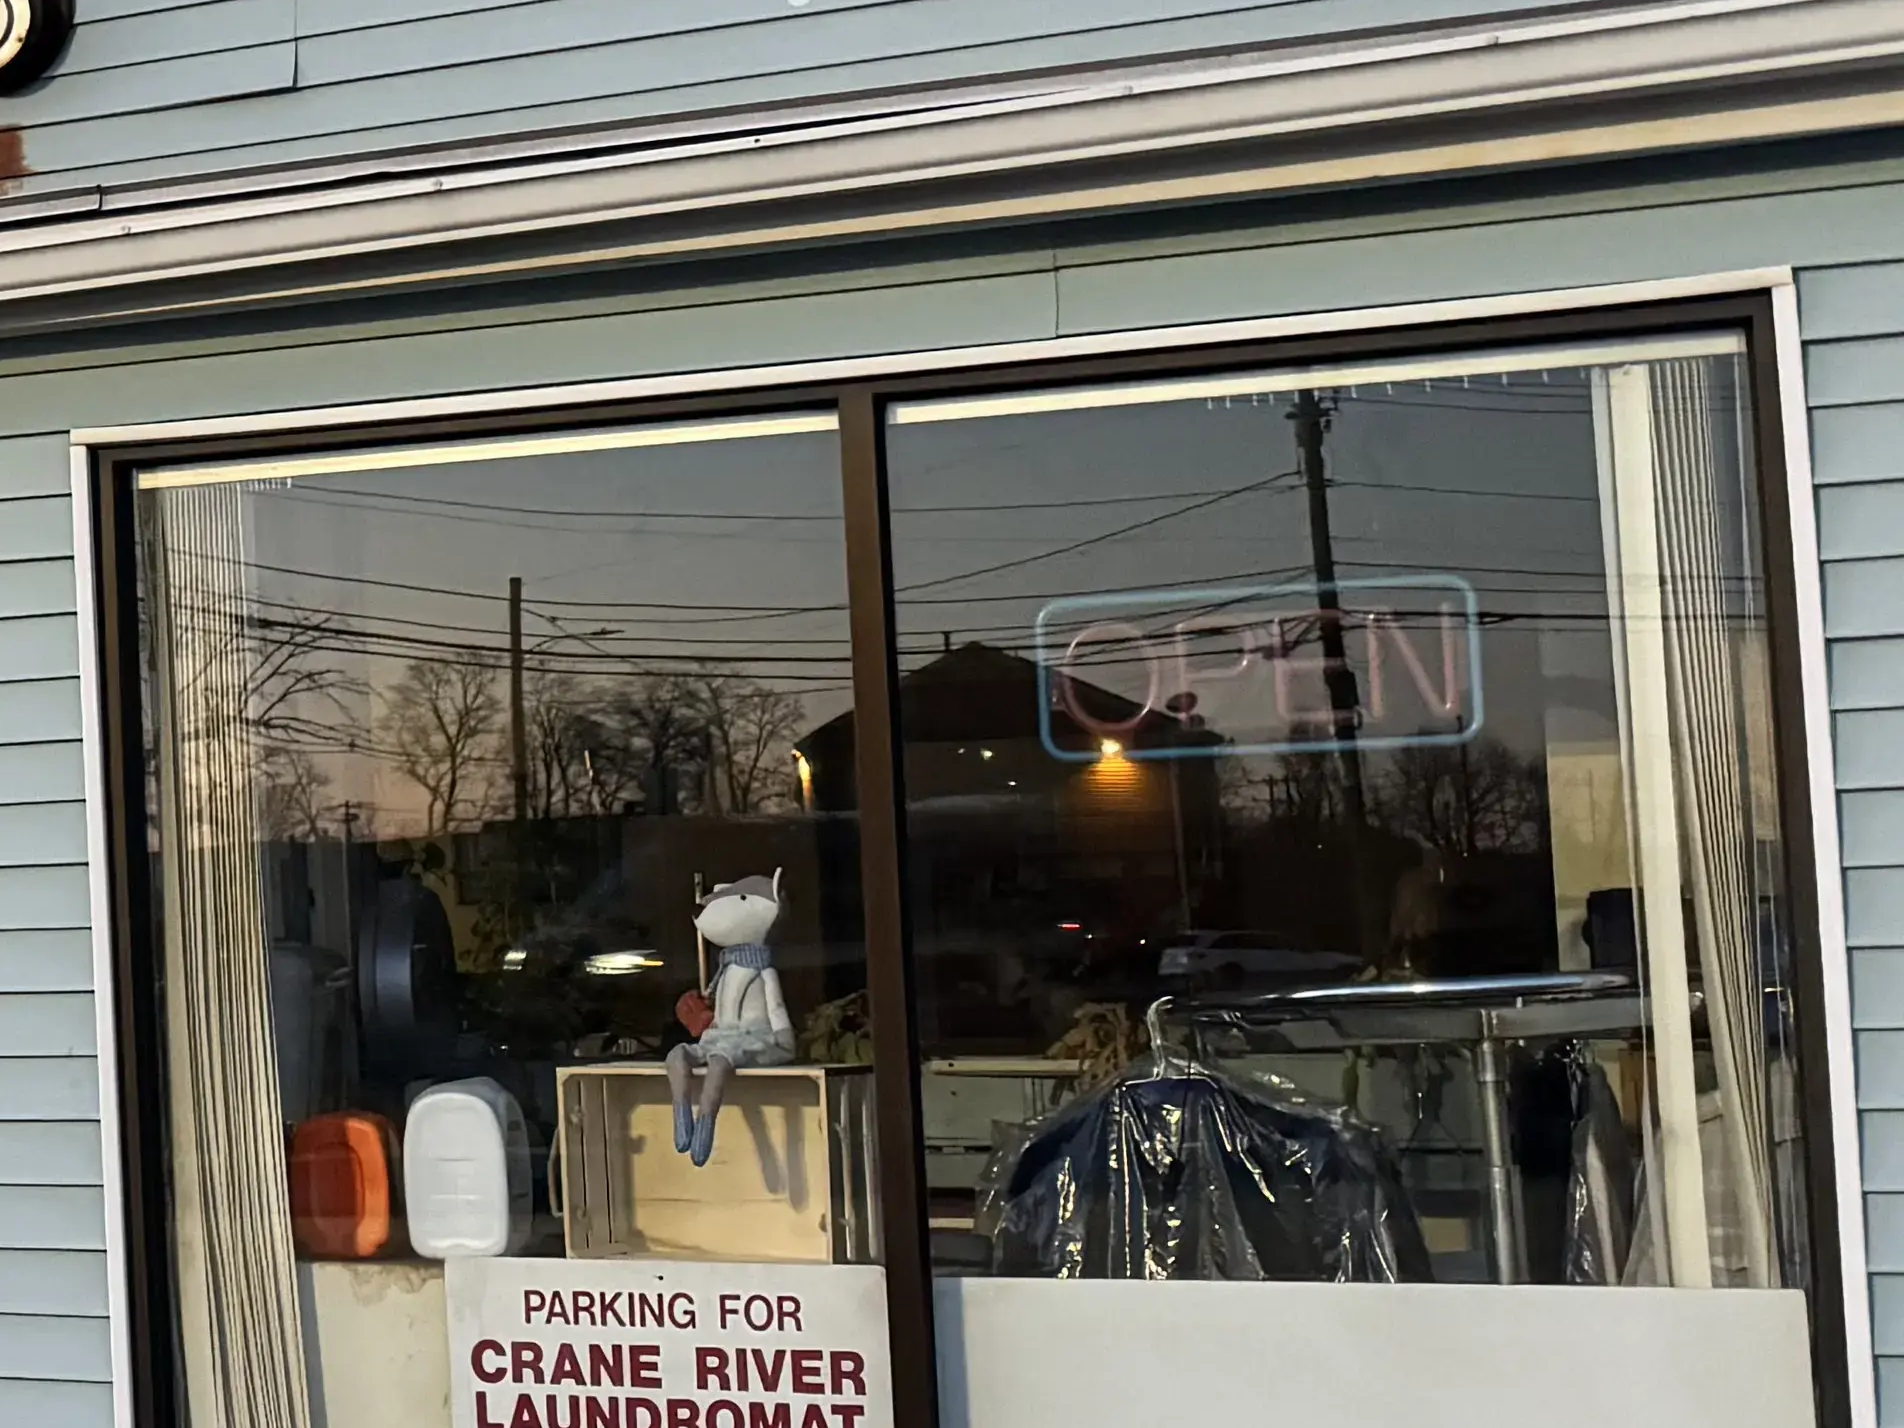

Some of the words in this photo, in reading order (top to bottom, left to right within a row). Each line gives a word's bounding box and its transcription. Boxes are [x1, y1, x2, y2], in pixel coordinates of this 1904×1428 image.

[1061, 600, 1462, 733] OPEN
[524, 1289, 697, 1330] PARKING
[718, 1294, 804, 1332] FOR
[470, 1339, 663, 1389] CRANE
[695, 1346, 867, 1396] RIVER
